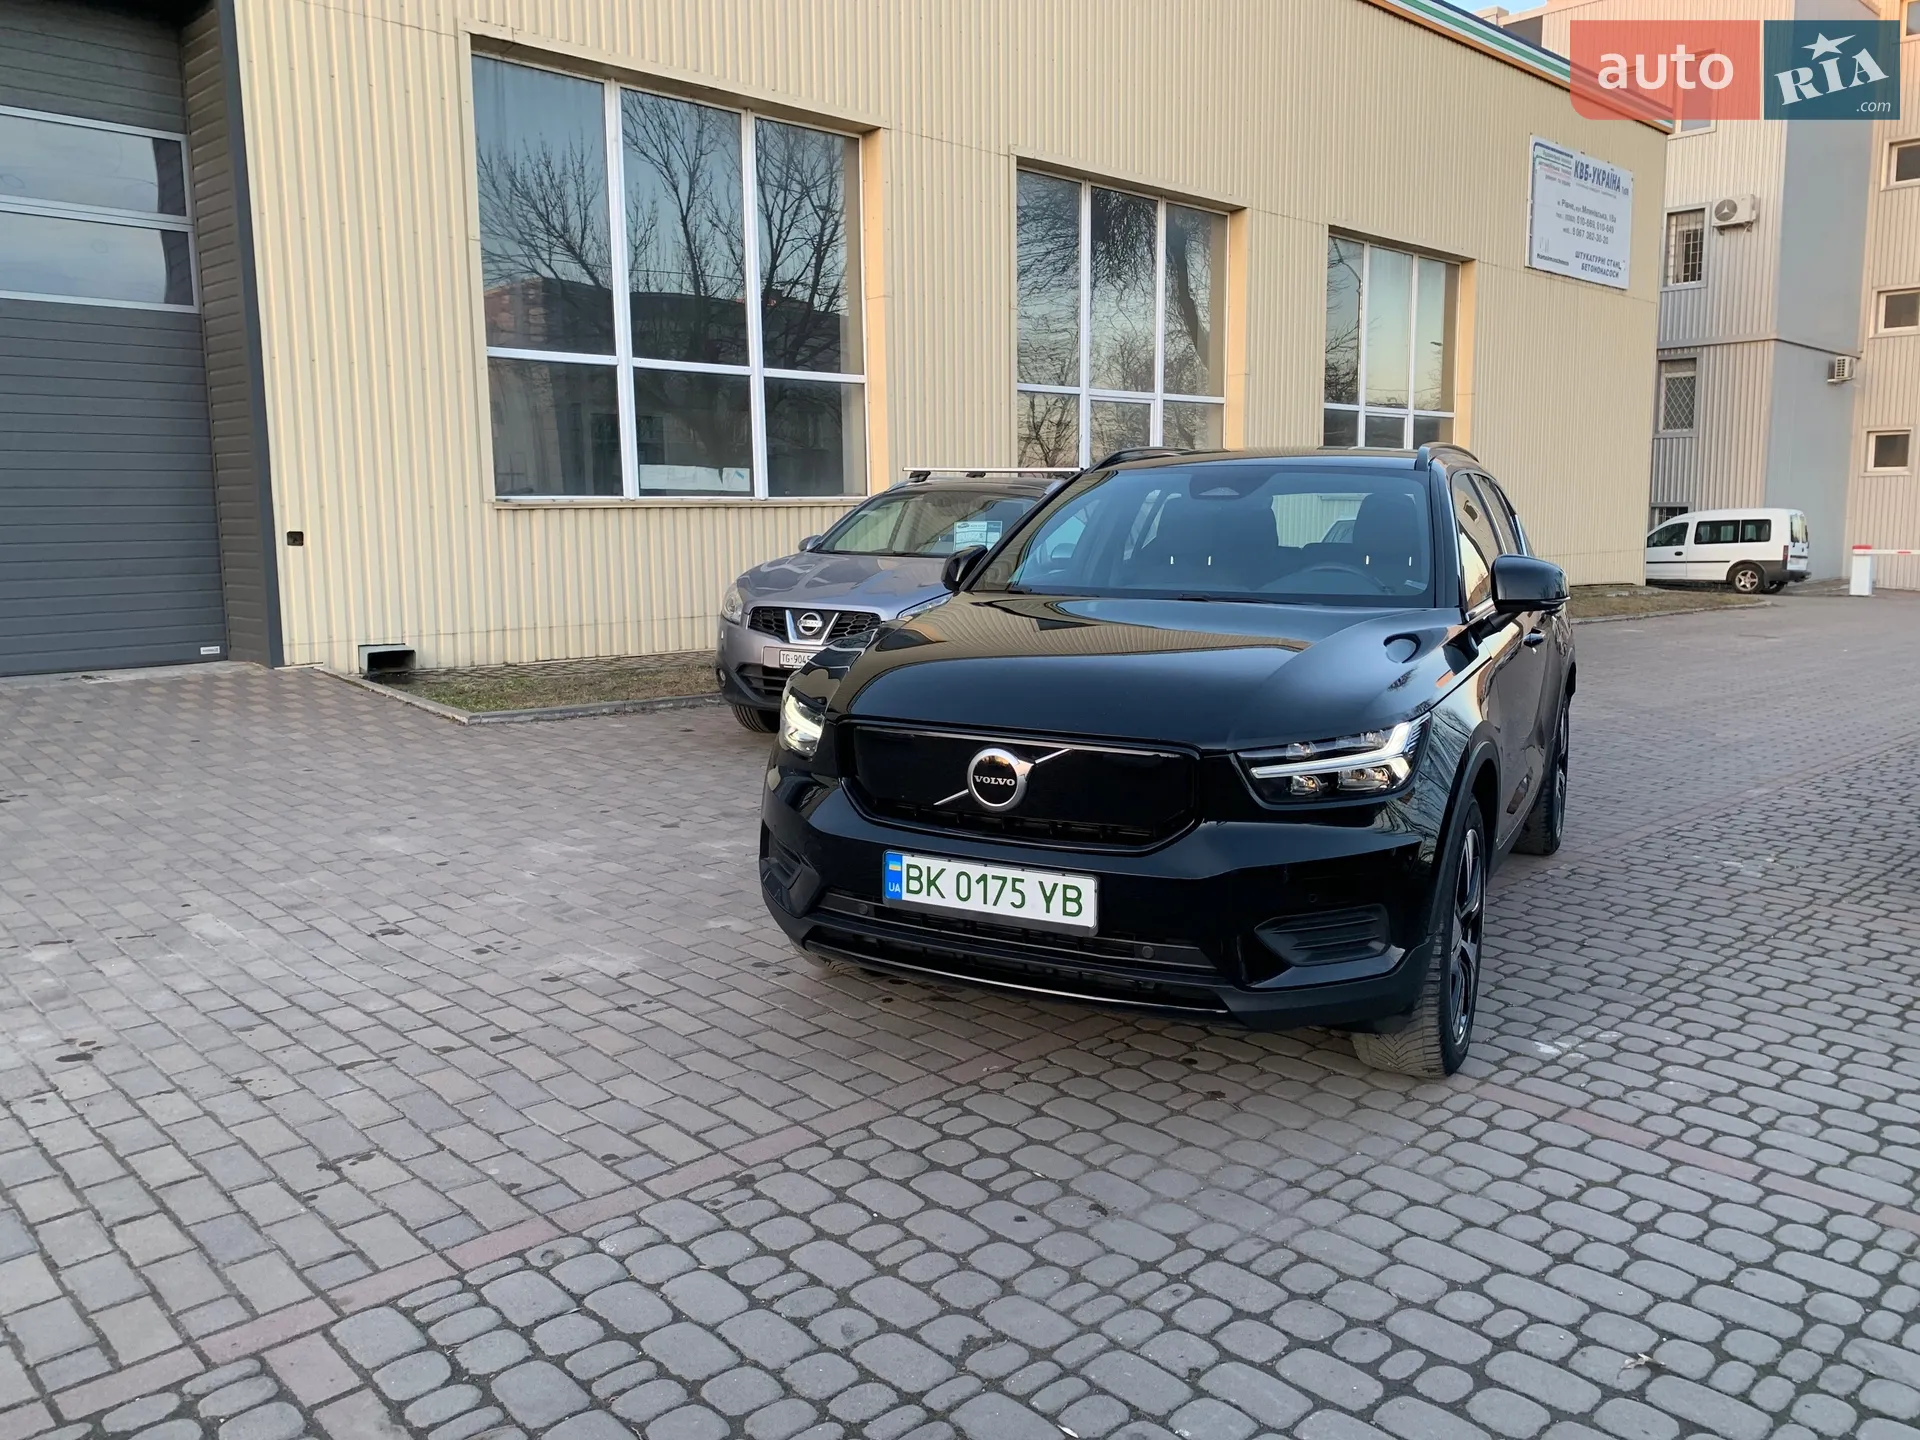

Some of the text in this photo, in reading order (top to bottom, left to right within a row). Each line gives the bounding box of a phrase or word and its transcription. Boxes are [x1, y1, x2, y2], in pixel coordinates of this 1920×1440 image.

[1573, 160, 1621, 193] КВБ-УКРАЇНА
[974, 775, 1016, 787] VOLVO
[888, 882, 901, 893] UA
[906, 863, 1083, 918] BK 0175 YB
